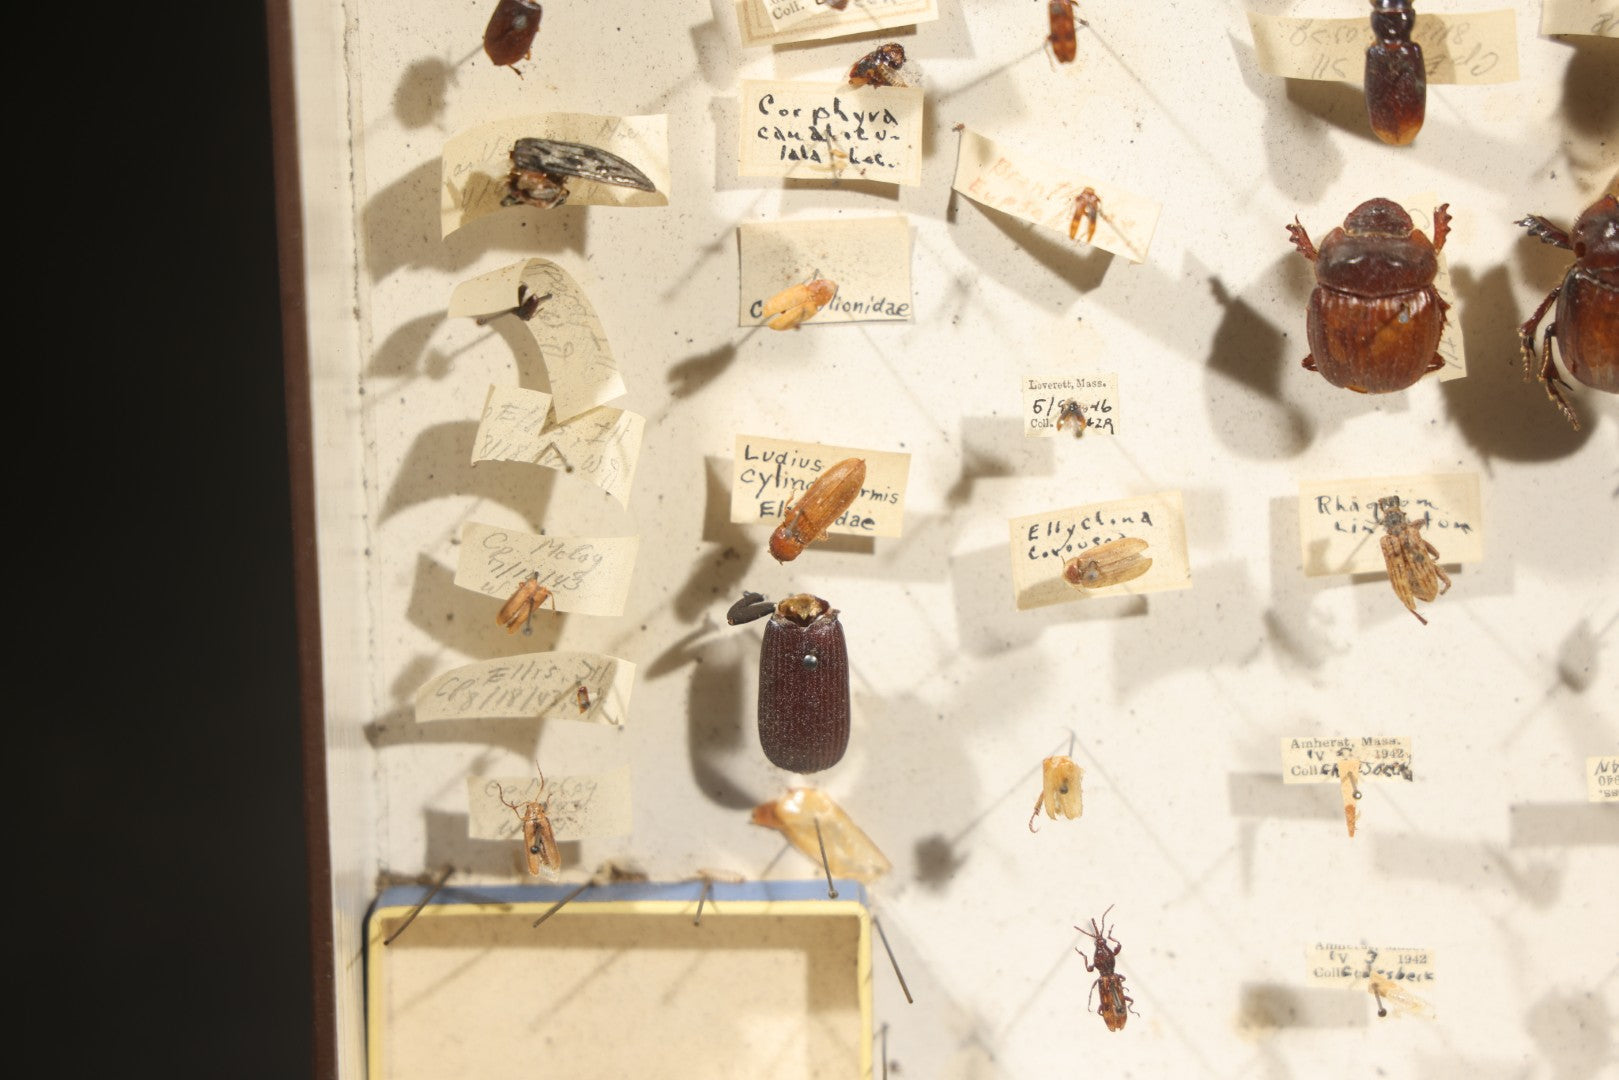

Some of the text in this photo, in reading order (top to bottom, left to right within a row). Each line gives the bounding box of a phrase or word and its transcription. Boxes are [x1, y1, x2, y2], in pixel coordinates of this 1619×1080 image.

[772, 3, 805, 20] Coll.
[1076, 379, 1107, 389] Mass.
[1030, 418, 1054, 429] Coll.
[744, 445, 824, 472] Ludius
[1291, 736, 1402, 749] Amherst, Mass.
[1375, 748, 1405, 759] 1942
[1398, 953, 1428, 965] 1942
